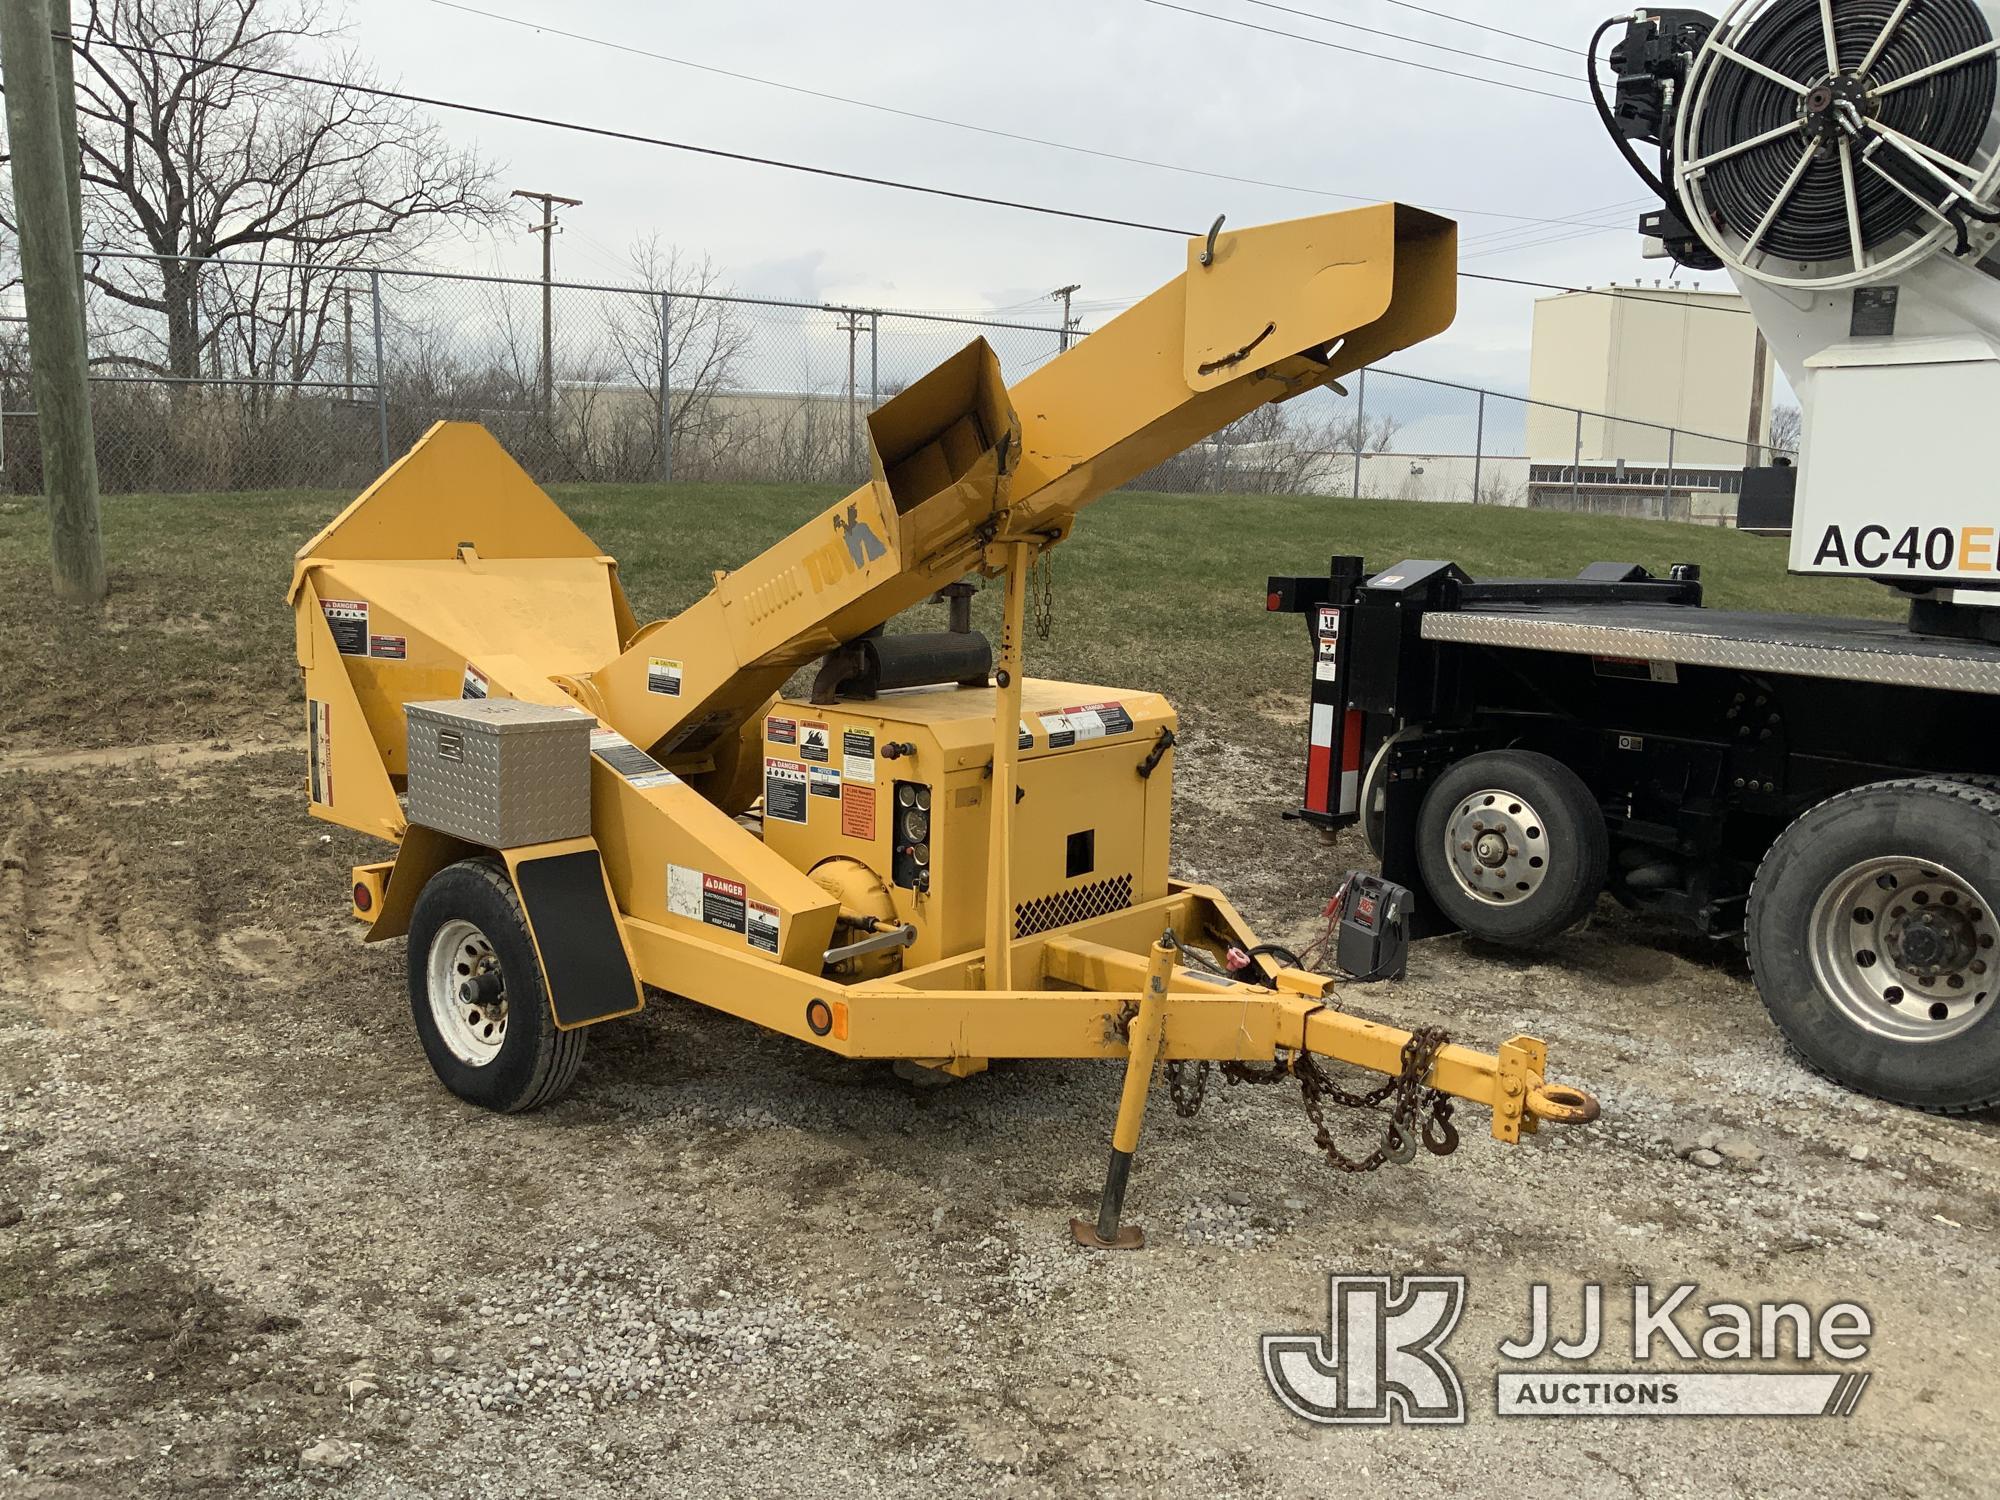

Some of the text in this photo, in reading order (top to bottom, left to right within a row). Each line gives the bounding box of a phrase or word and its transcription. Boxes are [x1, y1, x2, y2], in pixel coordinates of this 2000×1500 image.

[1812, 524, 2000, 571] AC40E
[332, 602, 358, 610] DANGER
[777, 762, 799, 771] DANGER
[713, 880, 743, 896] DANGER
[723, 921, 736, 929] CLEAR
